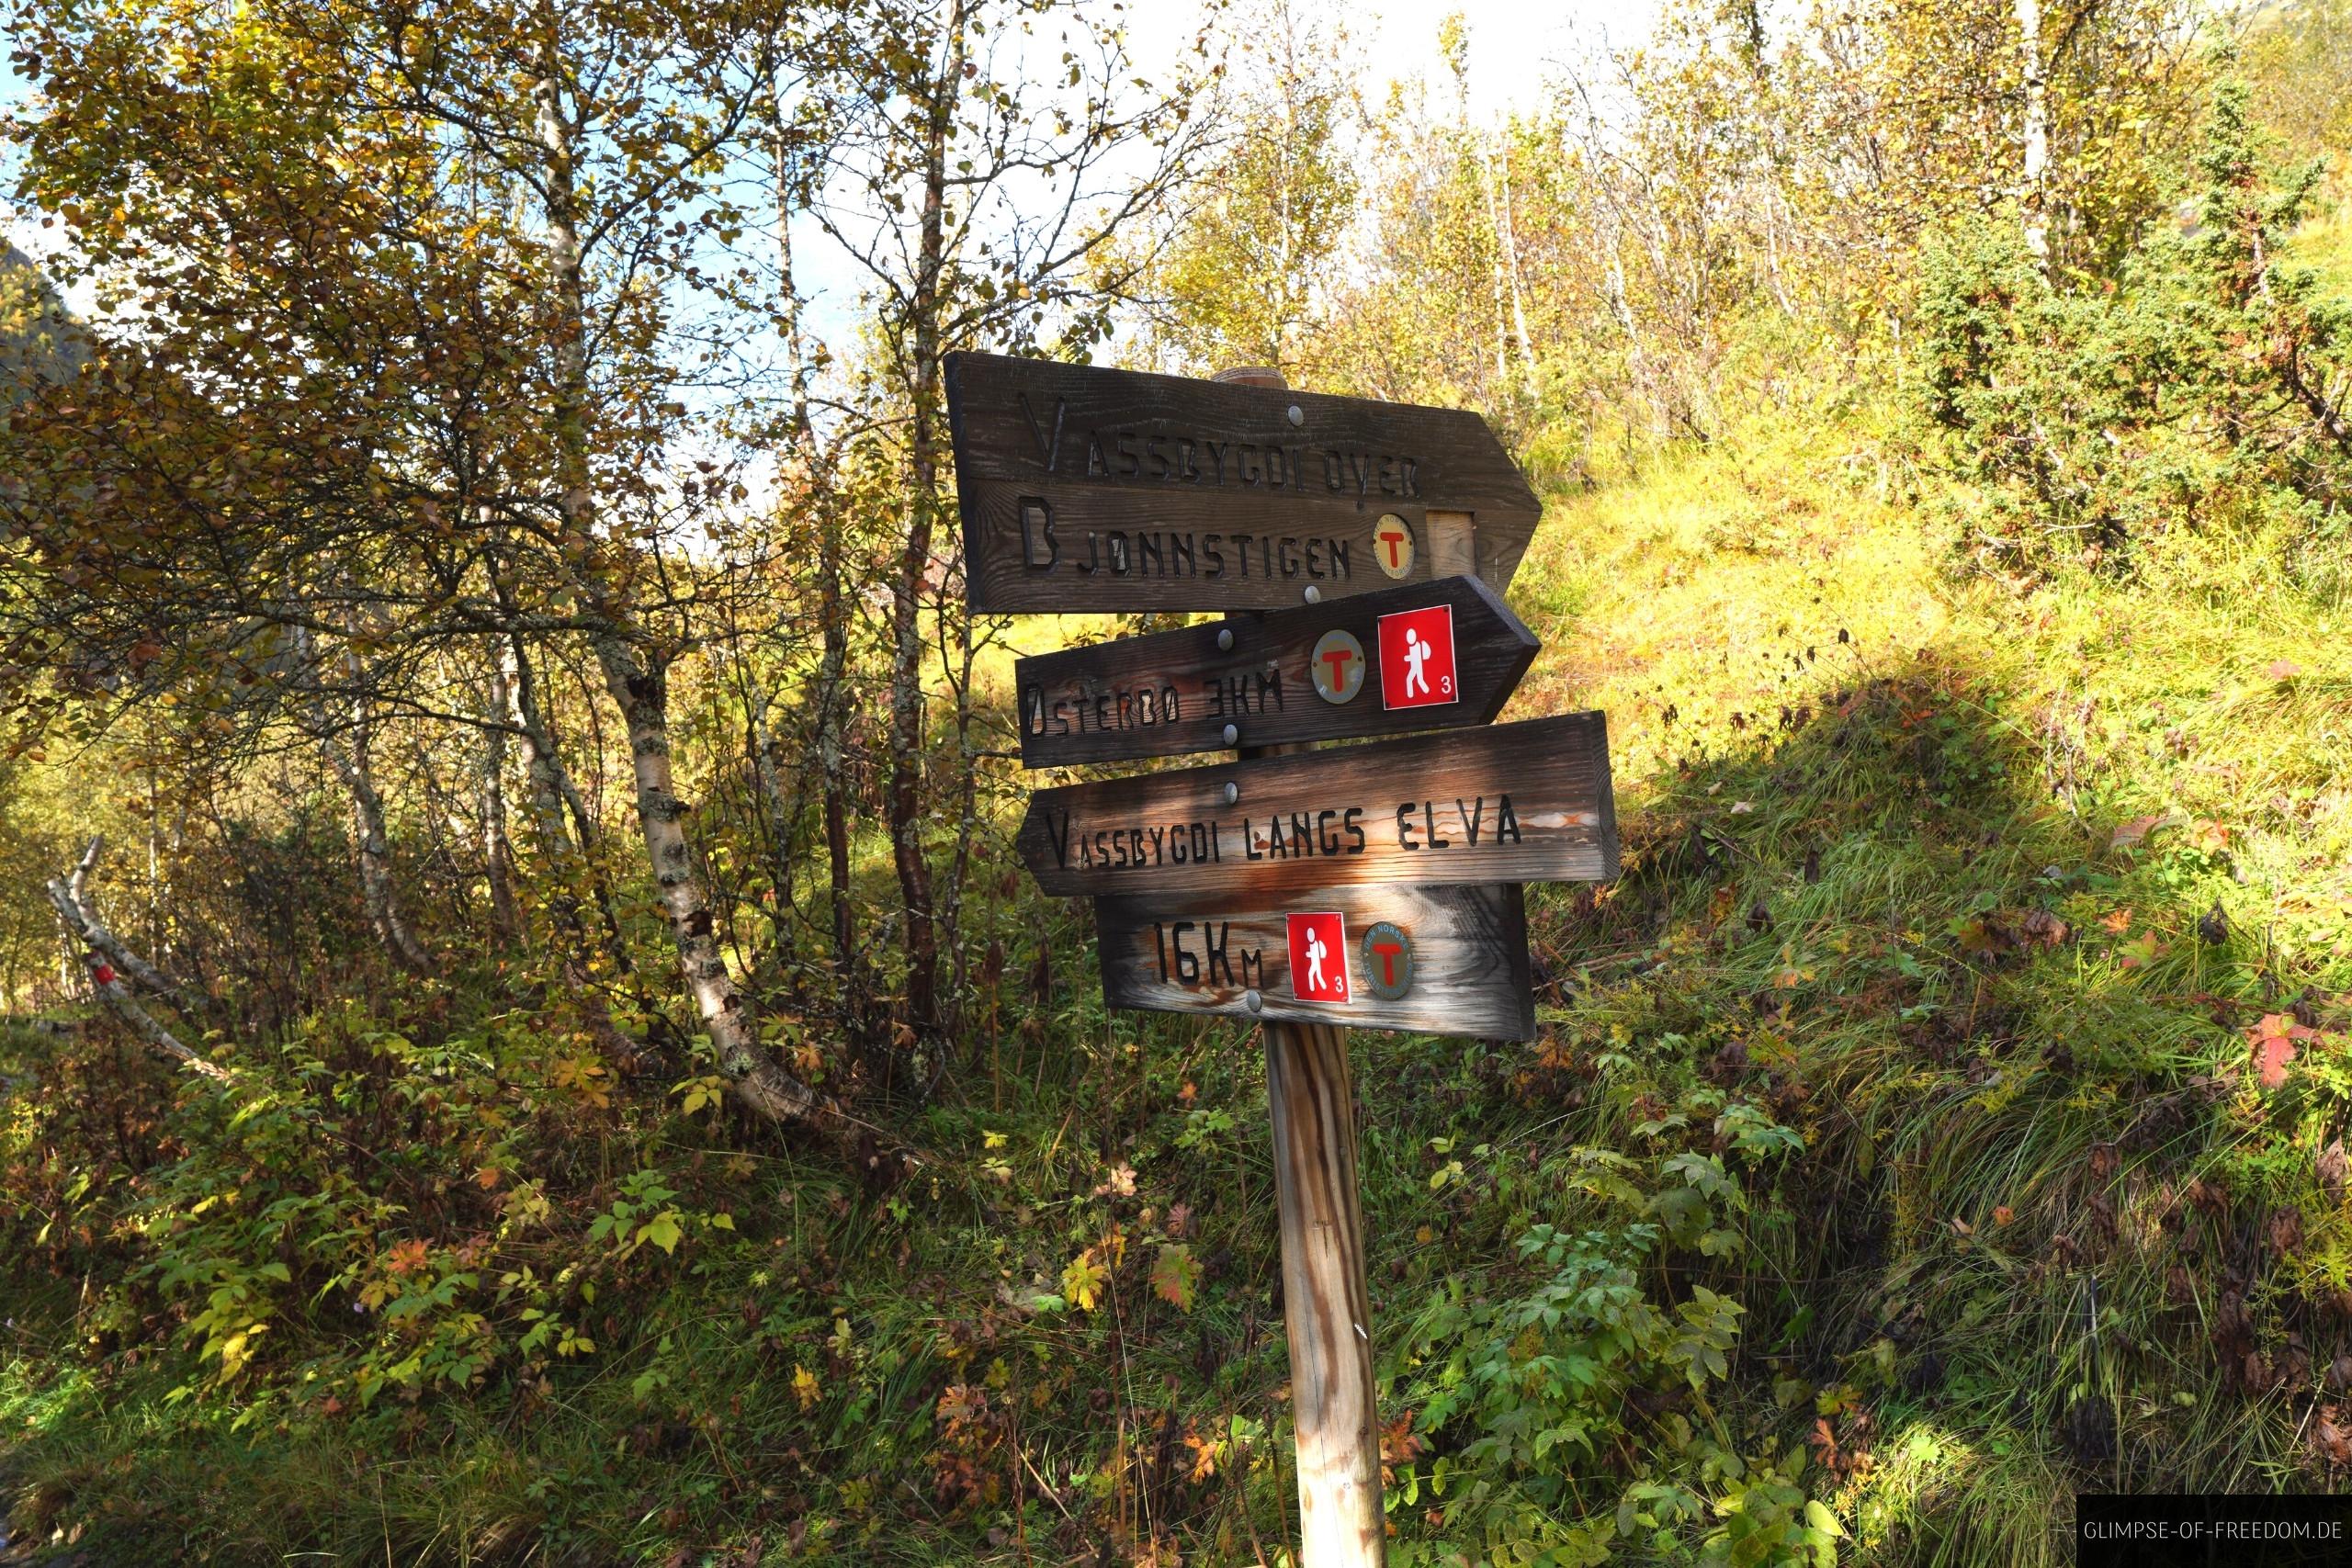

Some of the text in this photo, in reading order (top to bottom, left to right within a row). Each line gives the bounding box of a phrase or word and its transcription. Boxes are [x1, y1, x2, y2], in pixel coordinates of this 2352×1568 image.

[1380, 532, 1404, 568] T
[1322, 649, 1352, 693] T
[1441, 675, 1452, 694] 3
[1046, 793, 1521, 869] VASSBYGDI LANGS ELVA
[1334, 976, 1344, 993] 3
[1372, 942, 1402, 987] T
